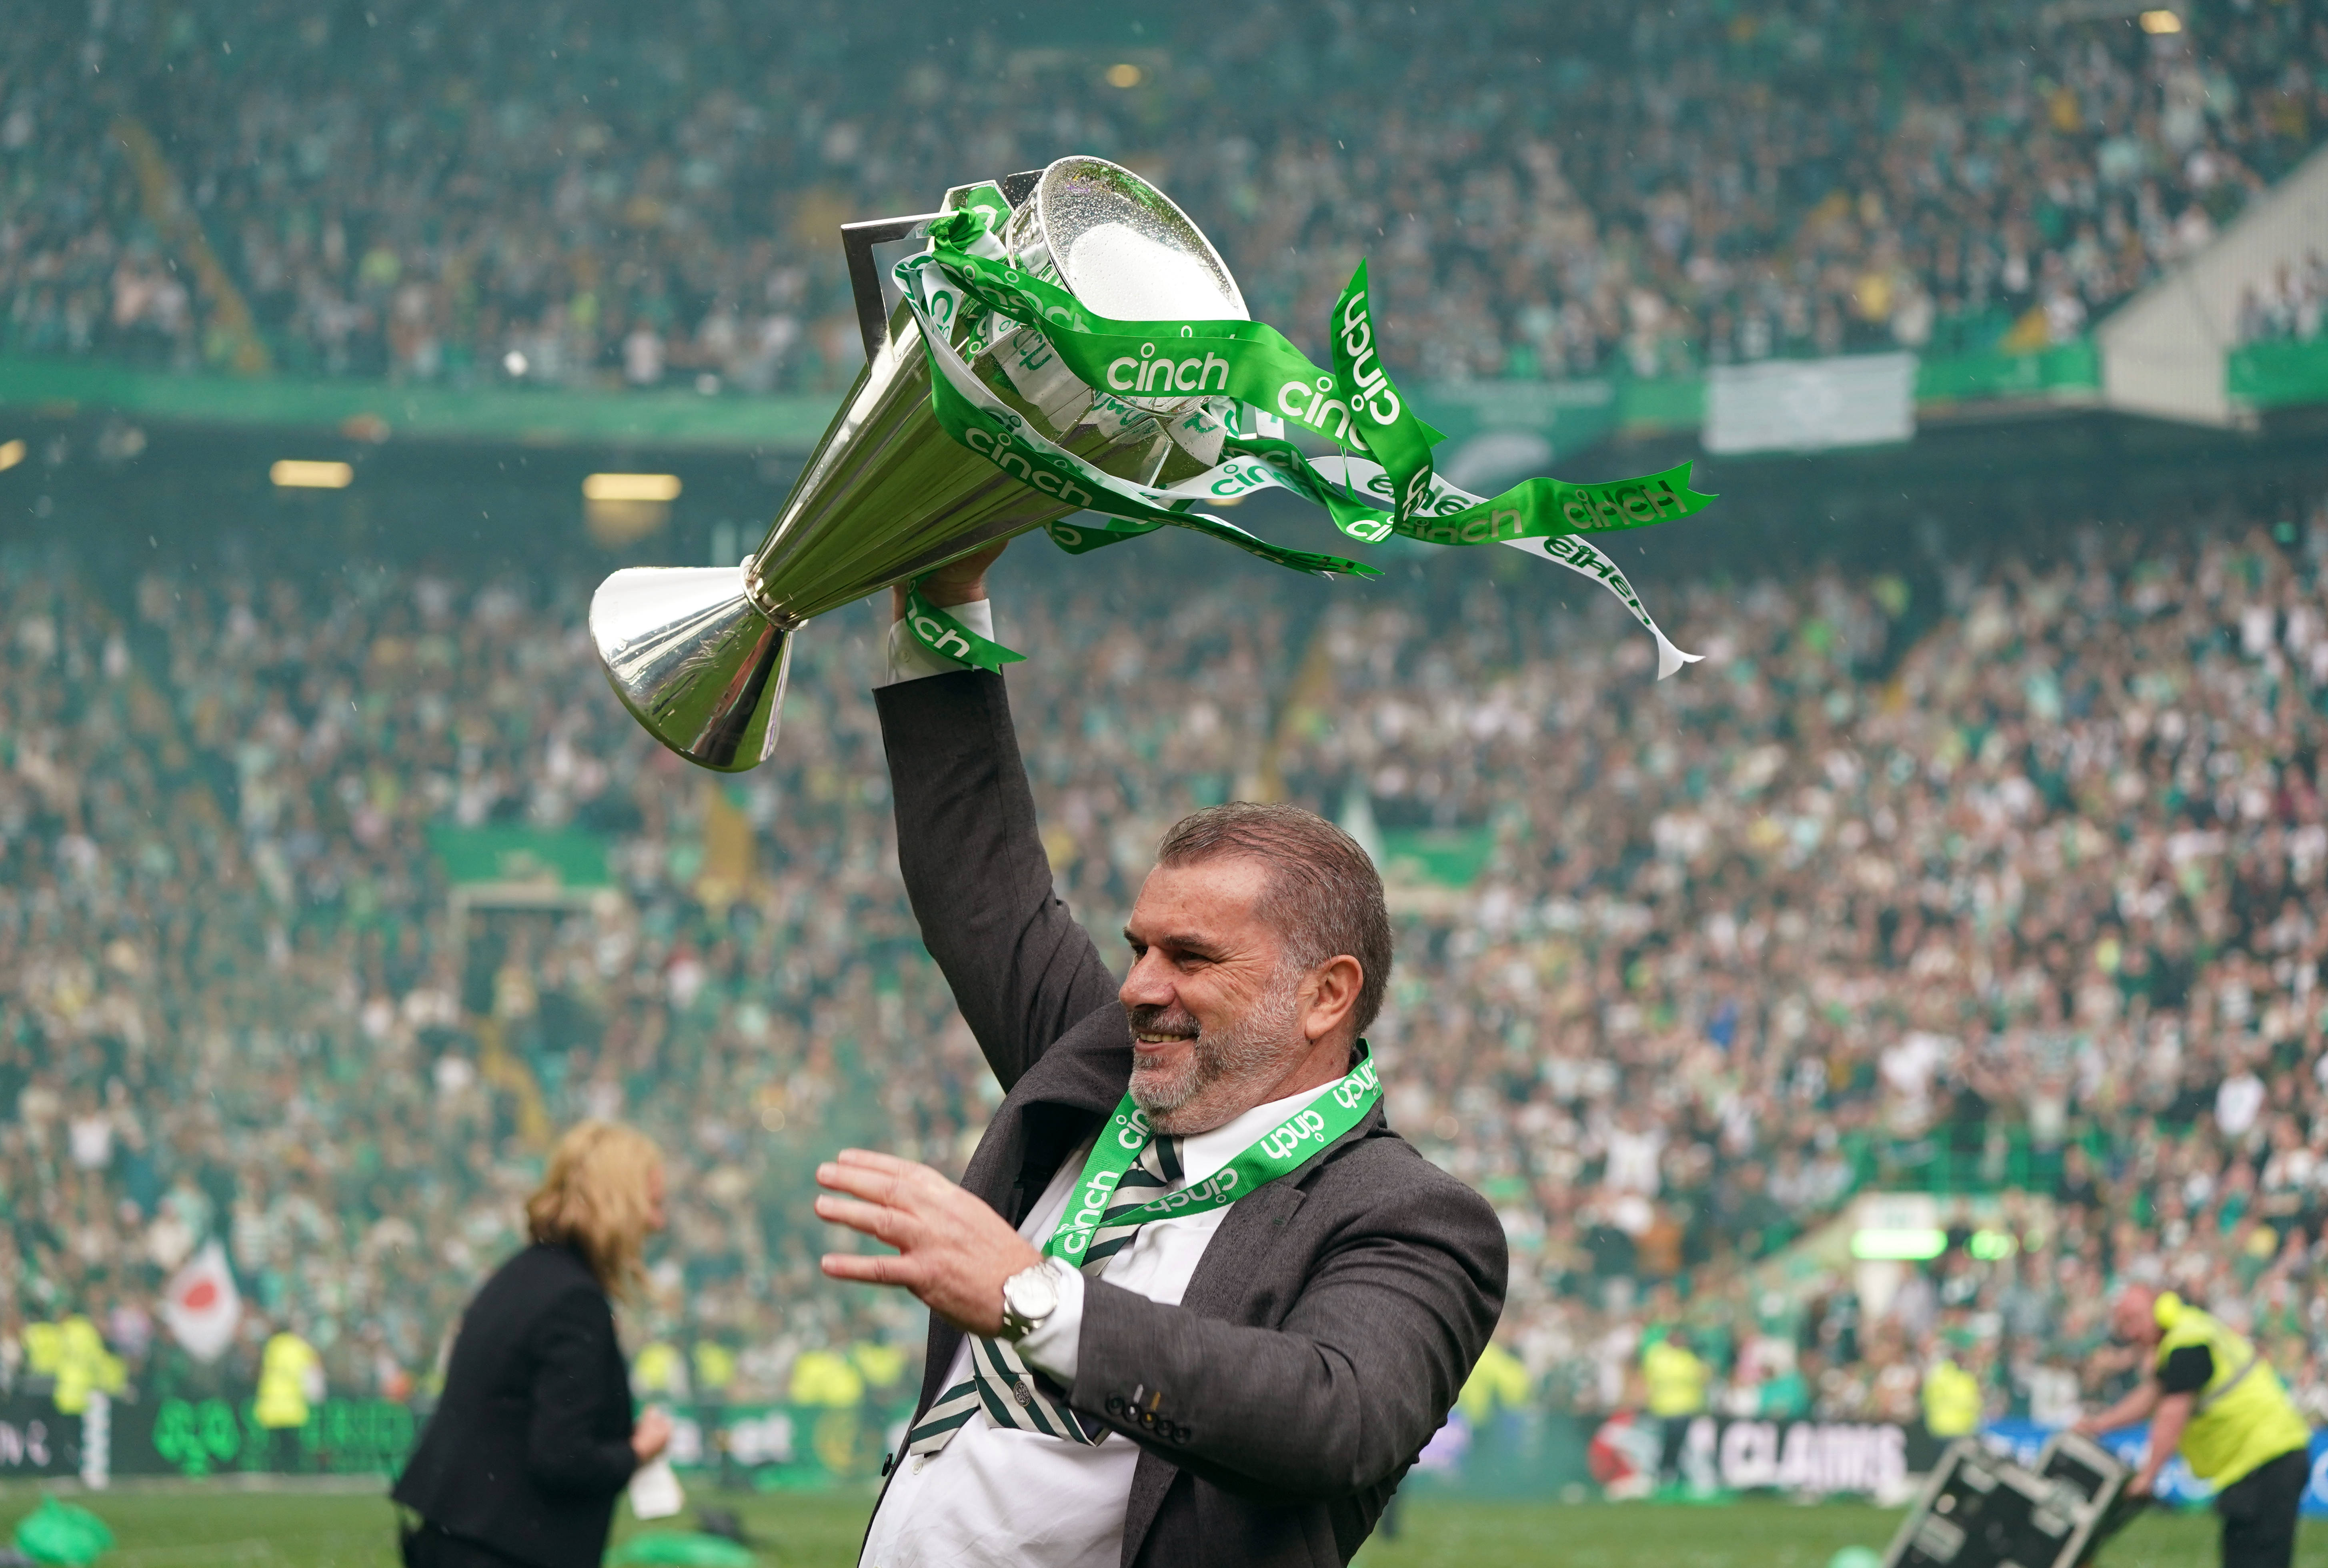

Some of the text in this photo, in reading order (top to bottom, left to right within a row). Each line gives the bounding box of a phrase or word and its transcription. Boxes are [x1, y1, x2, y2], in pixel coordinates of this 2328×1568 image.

[1107, 342, 1229, 391] cinch
[1341, 290, 1400, 425] cinch
[965, 428, 1093, 507] cinch
[1563, 489, 1687, 529] cinch
[1116, 1109, 1150, 1149] cin
[1261, 1110, 1324, 1159] cinch
[1144, 1168, 1238, 1212] cinch
